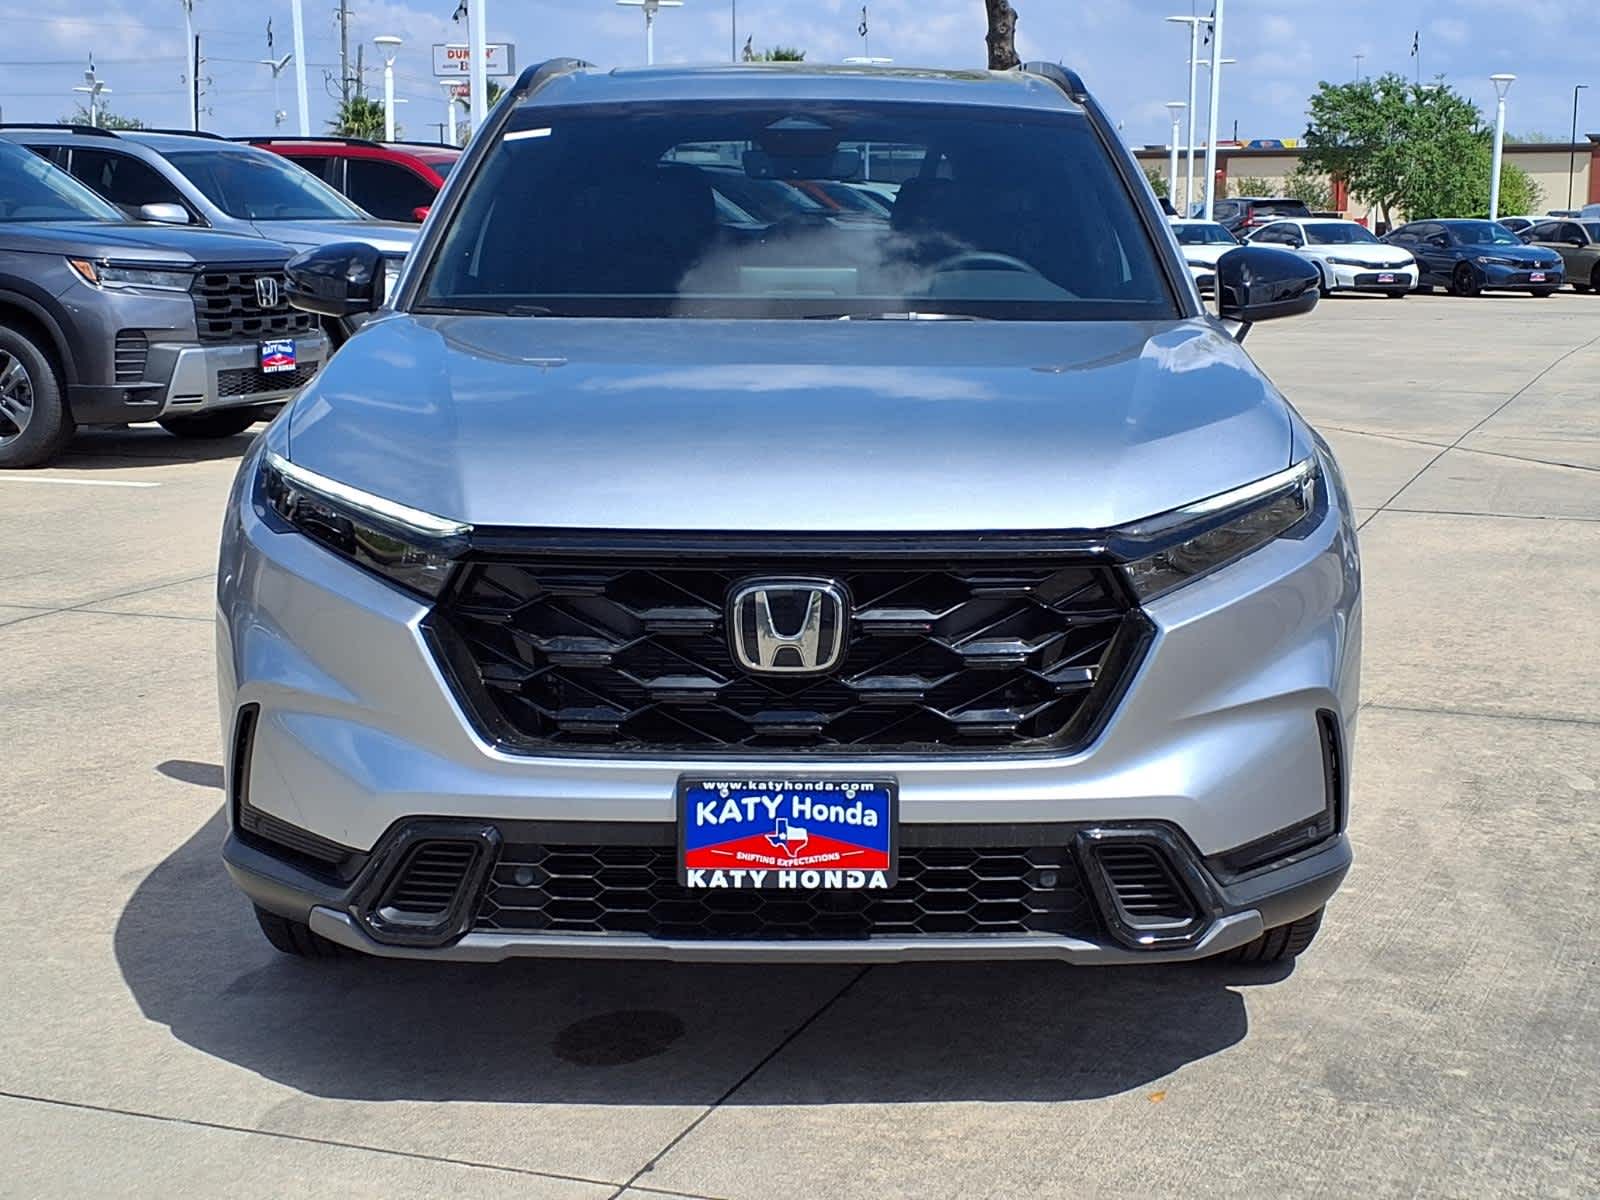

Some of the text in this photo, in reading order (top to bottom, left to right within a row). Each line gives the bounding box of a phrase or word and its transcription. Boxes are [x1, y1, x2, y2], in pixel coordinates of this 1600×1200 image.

[447, 49, 494, 59] DUN'
[702, 781, 875, 792] www.katyhonda.com
[696, 794, 878, 827] KATY Honda
[736, 851, 840, 867] SHIFTING EXPECTATIONS
[687, 870, 888, 889] KATY HONDA
